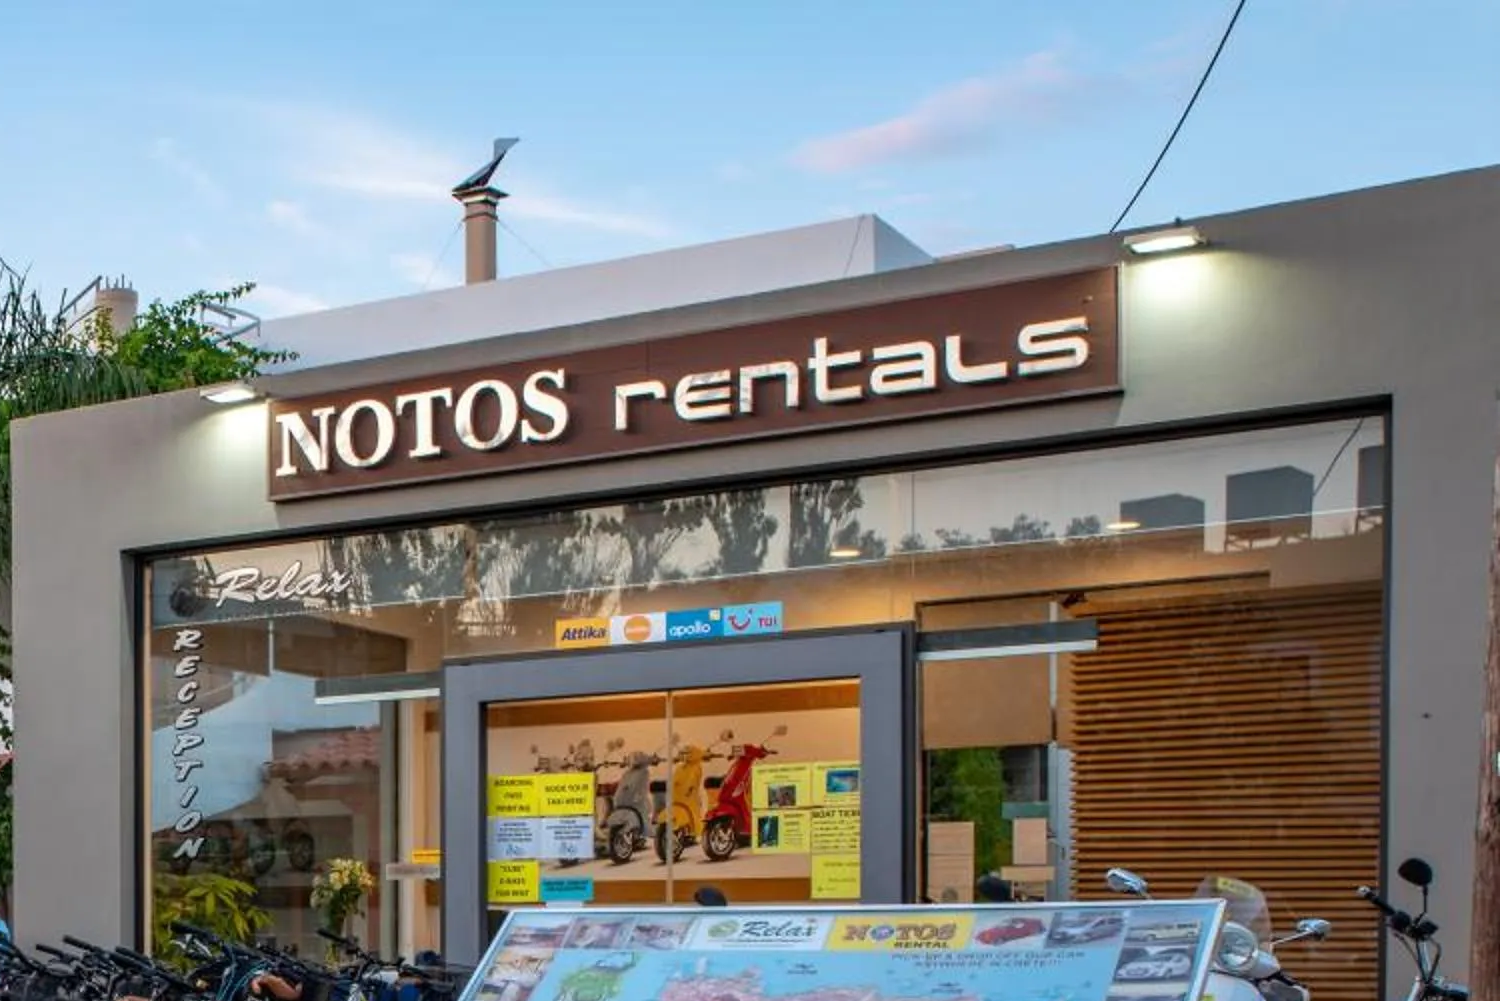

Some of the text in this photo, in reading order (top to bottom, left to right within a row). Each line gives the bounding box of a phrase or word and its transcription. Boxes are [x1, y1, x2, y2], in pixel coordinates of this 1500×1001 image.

[275, 316, 1090, 477] NOTOS rentals
[215, 560, 351, 608] Relax
[669, 620, 711, 637] apollo
[758, 617, 778, 629] TUI
[561, 626, 607, 641] Attika
[172, 629, 203, 858] RECEPTION
[740, 920, 818, 937] Relax
[893, 941, 949, 949] RENTAL
